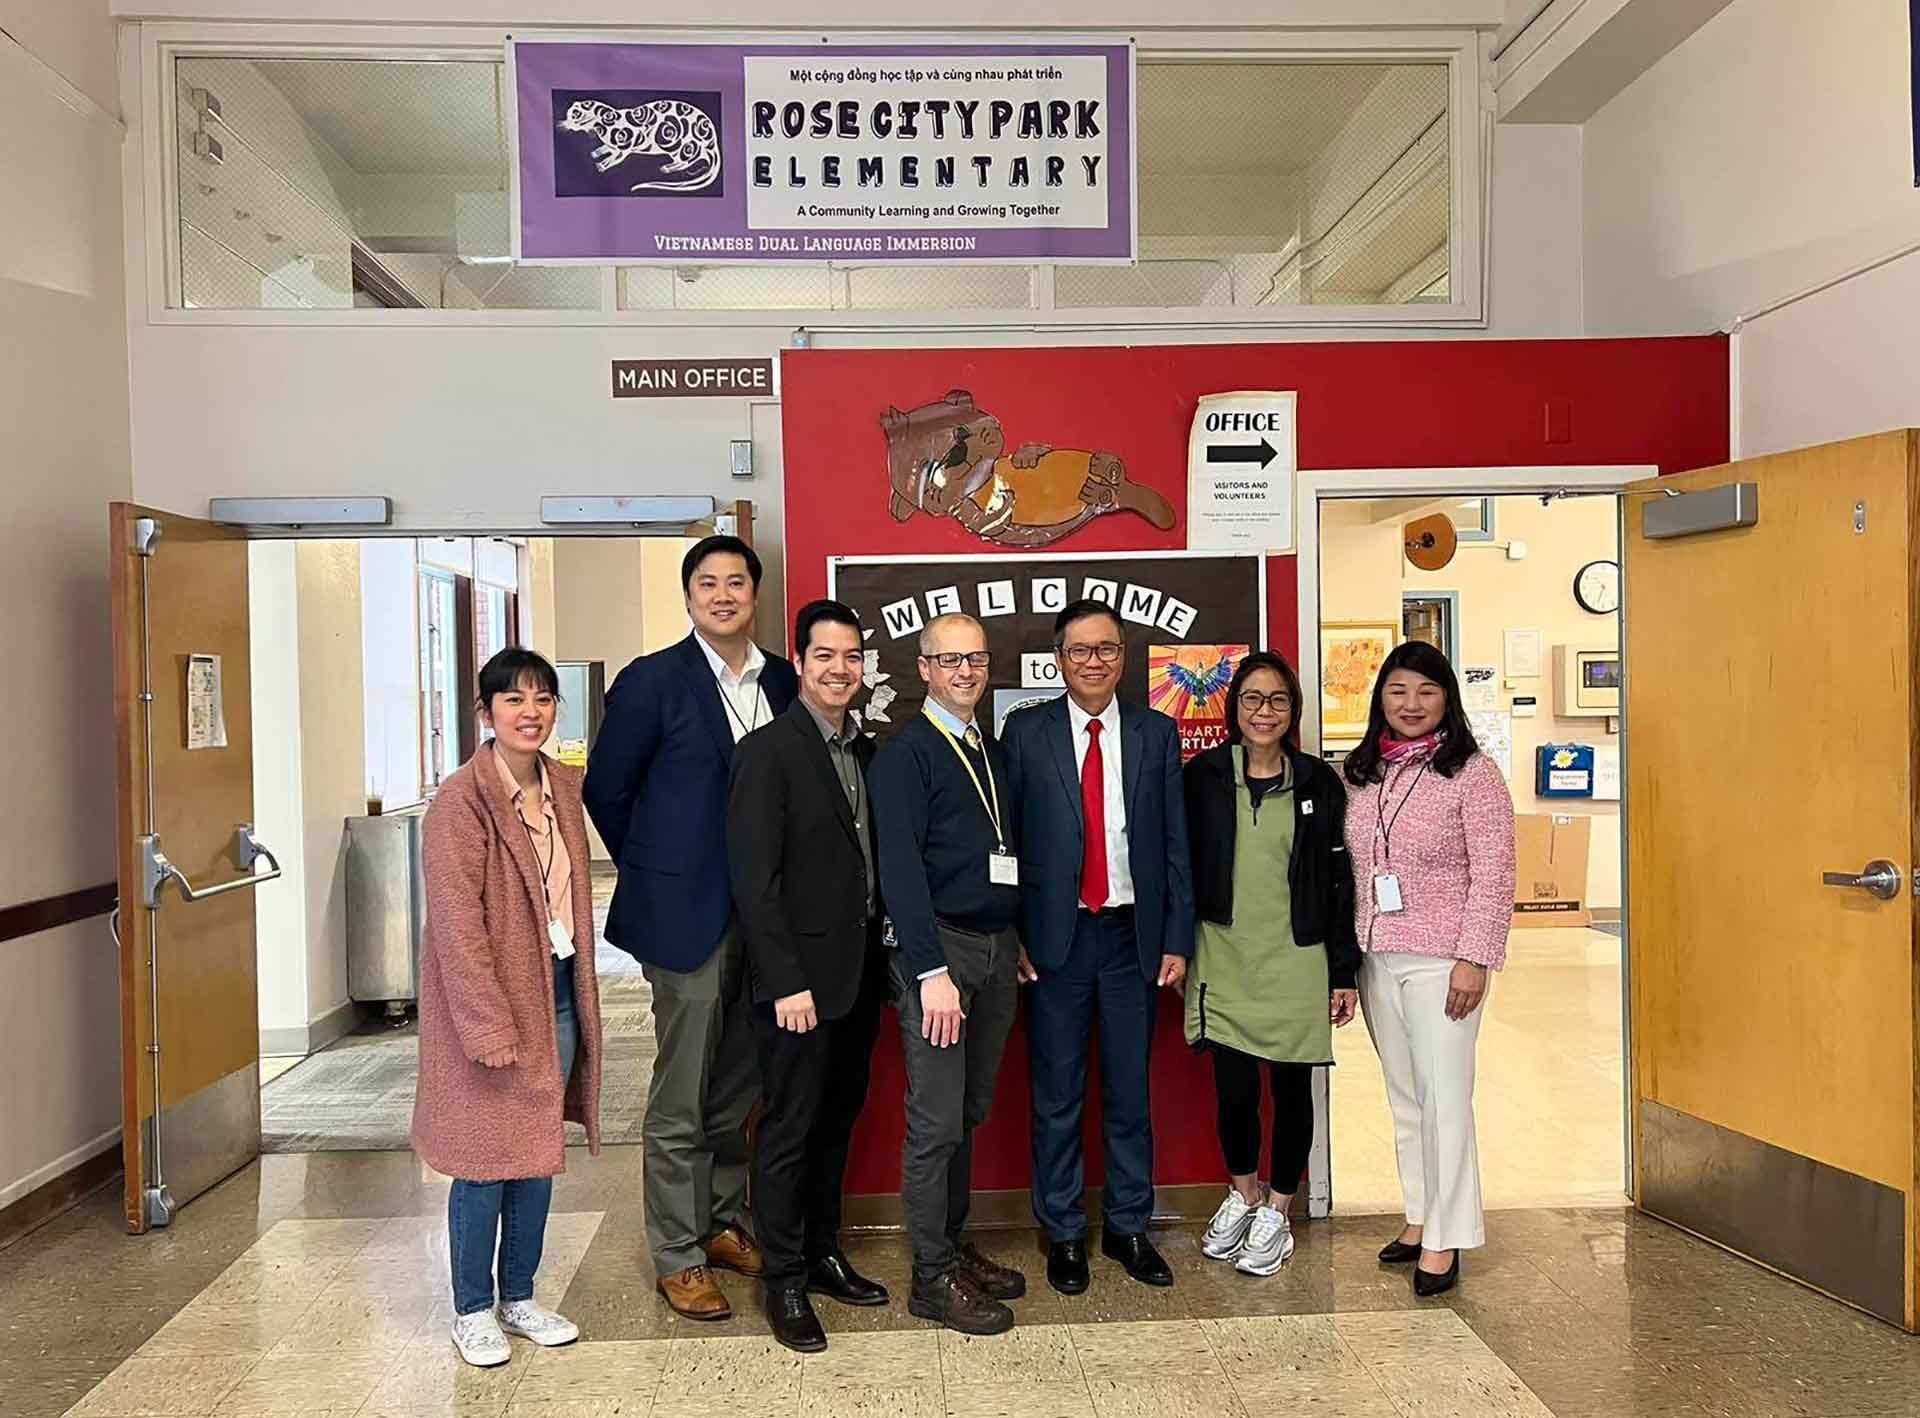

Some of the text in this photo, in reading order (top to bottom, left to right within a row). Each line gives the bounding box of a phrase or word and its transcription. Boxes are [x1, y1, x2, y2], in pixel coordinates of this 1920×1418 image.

[790, 66, 1063, 84] Một cộng đồng học tập và cùng nhau phát triển
[752, 100, 1100, 140] ROSE CITY PARK
[753, 155, 1101, 188] ELEMENTARY
[797, 204, 1061, 219] A Community Learning and Growing Together
[618, 367, 766, 389] MAIN OFFICE
[1205, 412, 1281, 432] OFFICE
[1214, 481, 1269, 490] VISITORS AND
[1213, 492, 1266, 500] VOLUNTEERS
[1030, 659, 1058, 680] to
